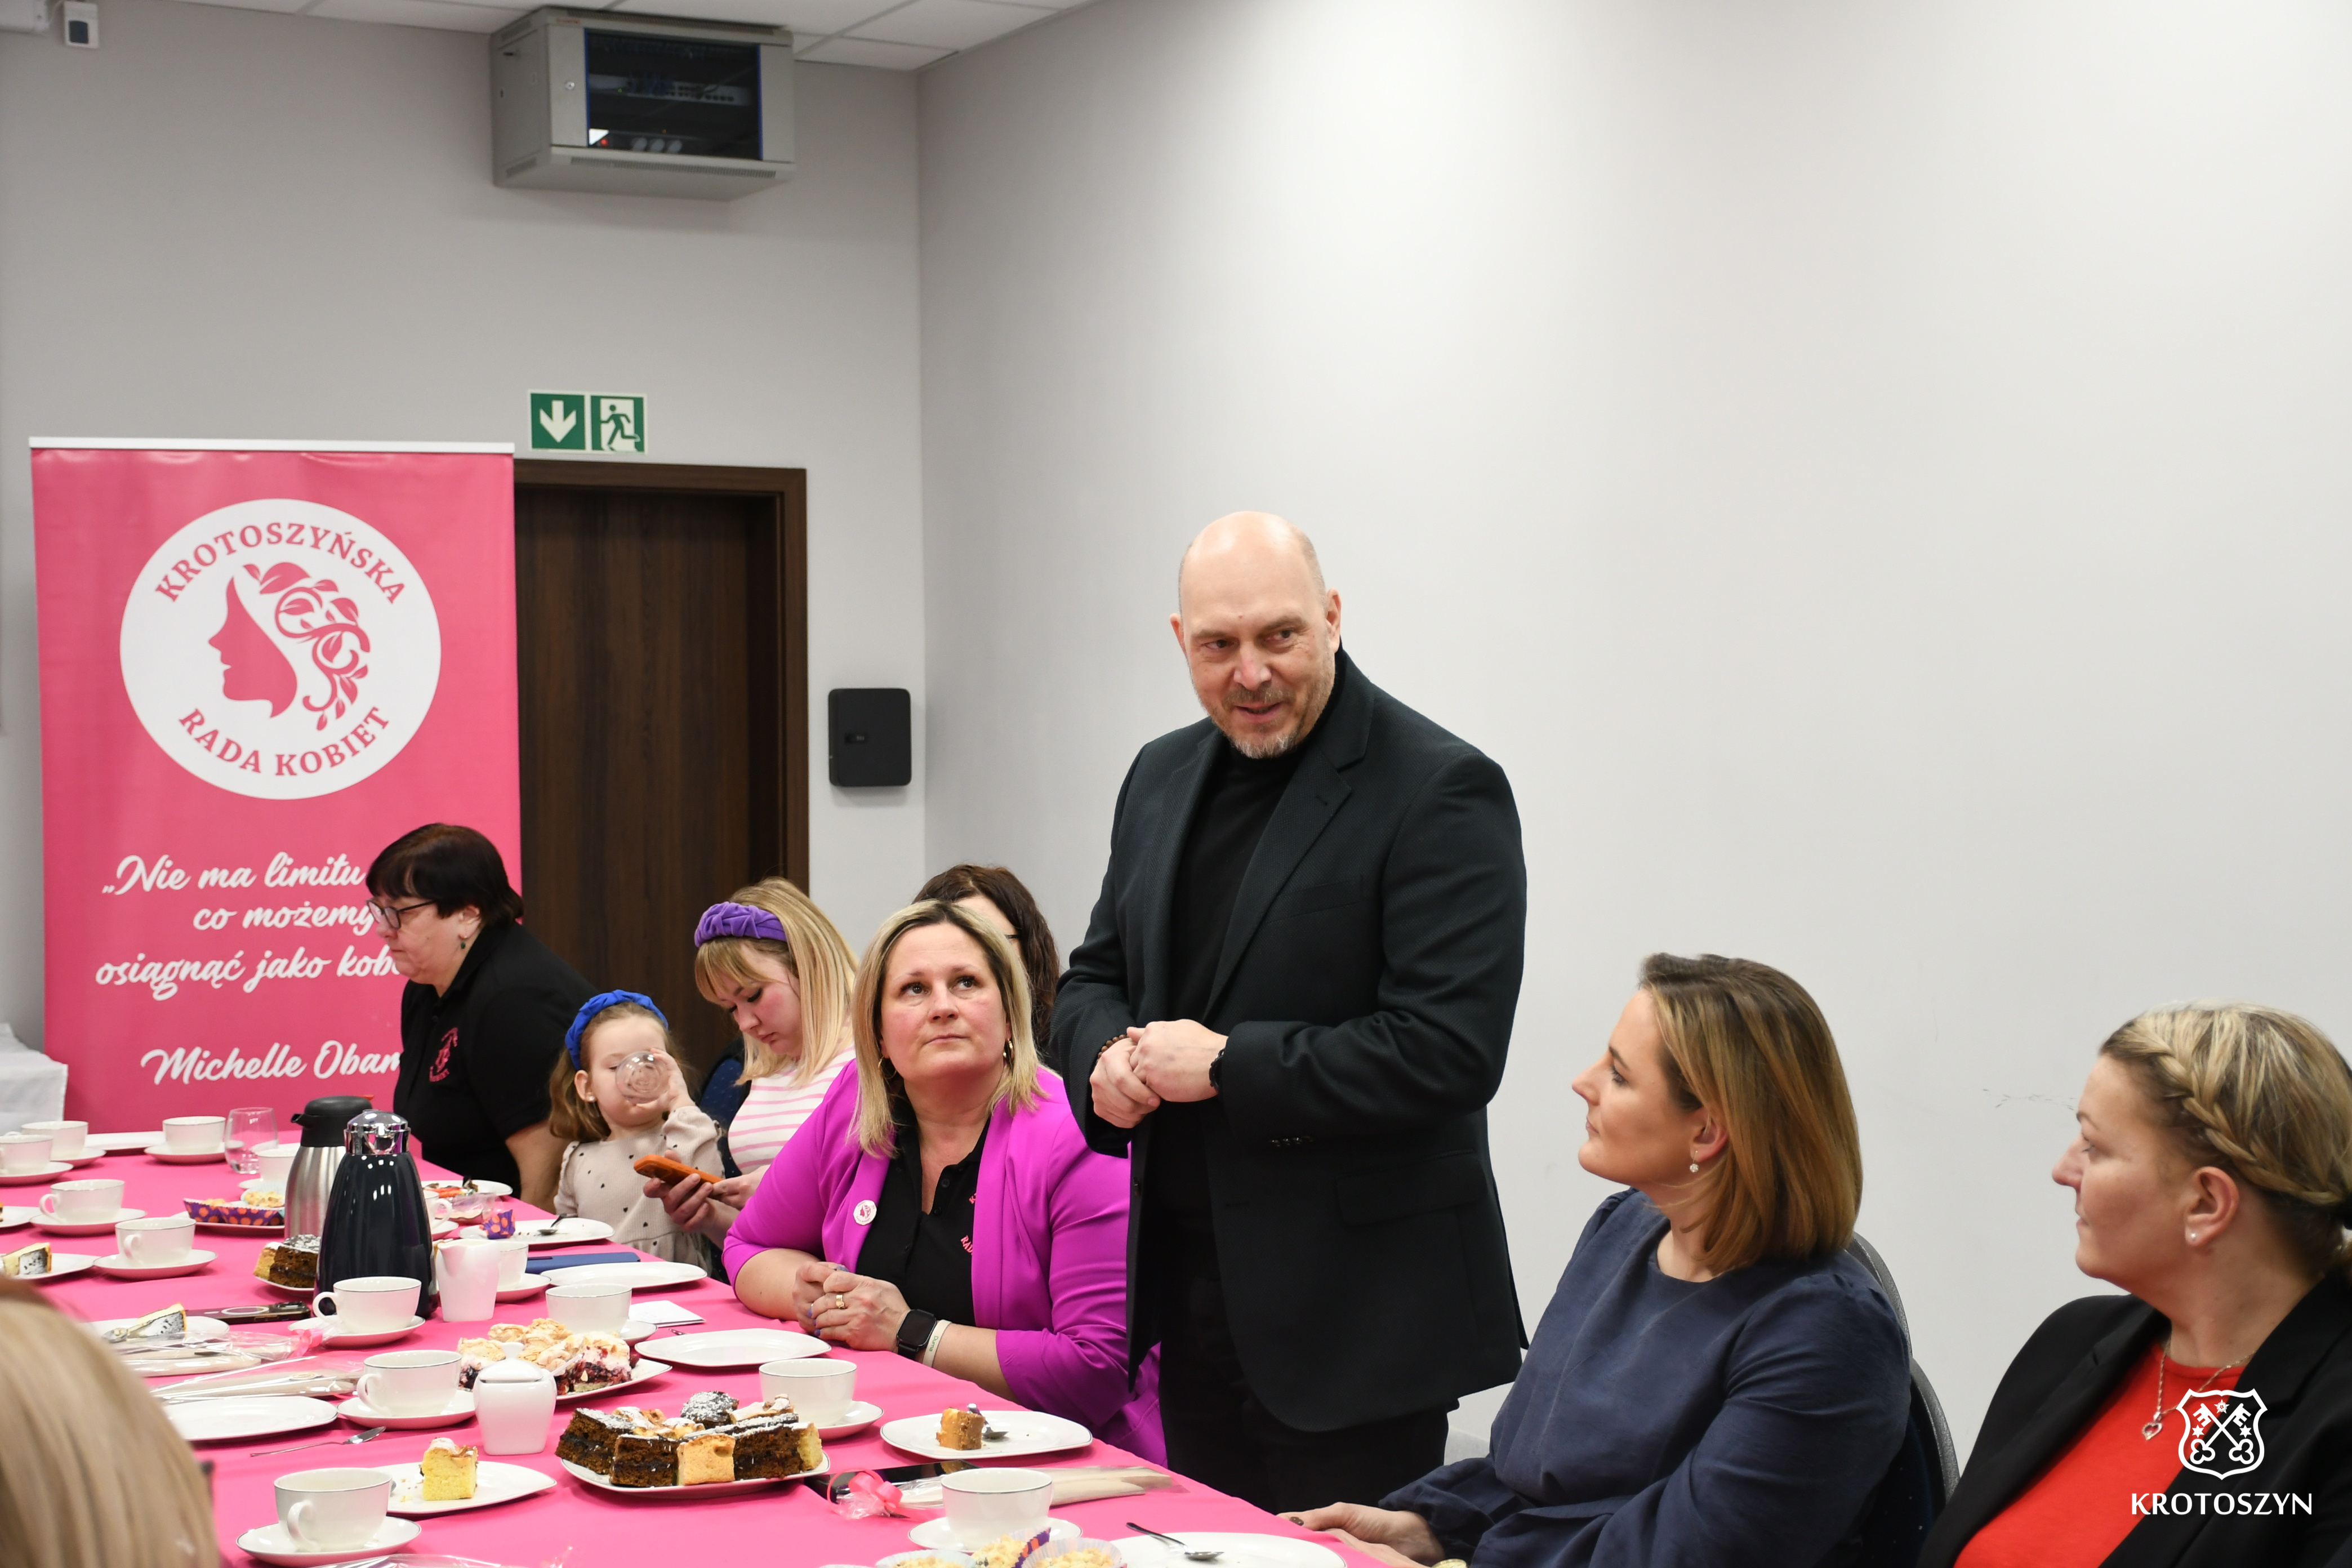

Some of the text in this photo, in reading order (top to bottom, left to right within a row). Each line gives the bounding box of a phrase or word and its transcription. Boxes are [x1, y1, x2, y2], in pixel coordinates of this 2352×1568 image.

[155, 522, 406, 604] KROTOSZYŃSKA
[179, 706, 390, 776] RADA KOBIET
[198, 867, 257, 889] ma
[264, 851, 366, 888] limitu
[193, 900, 375, 937] co możemy
[95, 950, 245, 1001] osiągnąć
[243, 946, 332, 994] jako
[140, 1039, 401, 1085] Michelle Obam
[960, 1235, 973, 1255] RAD
